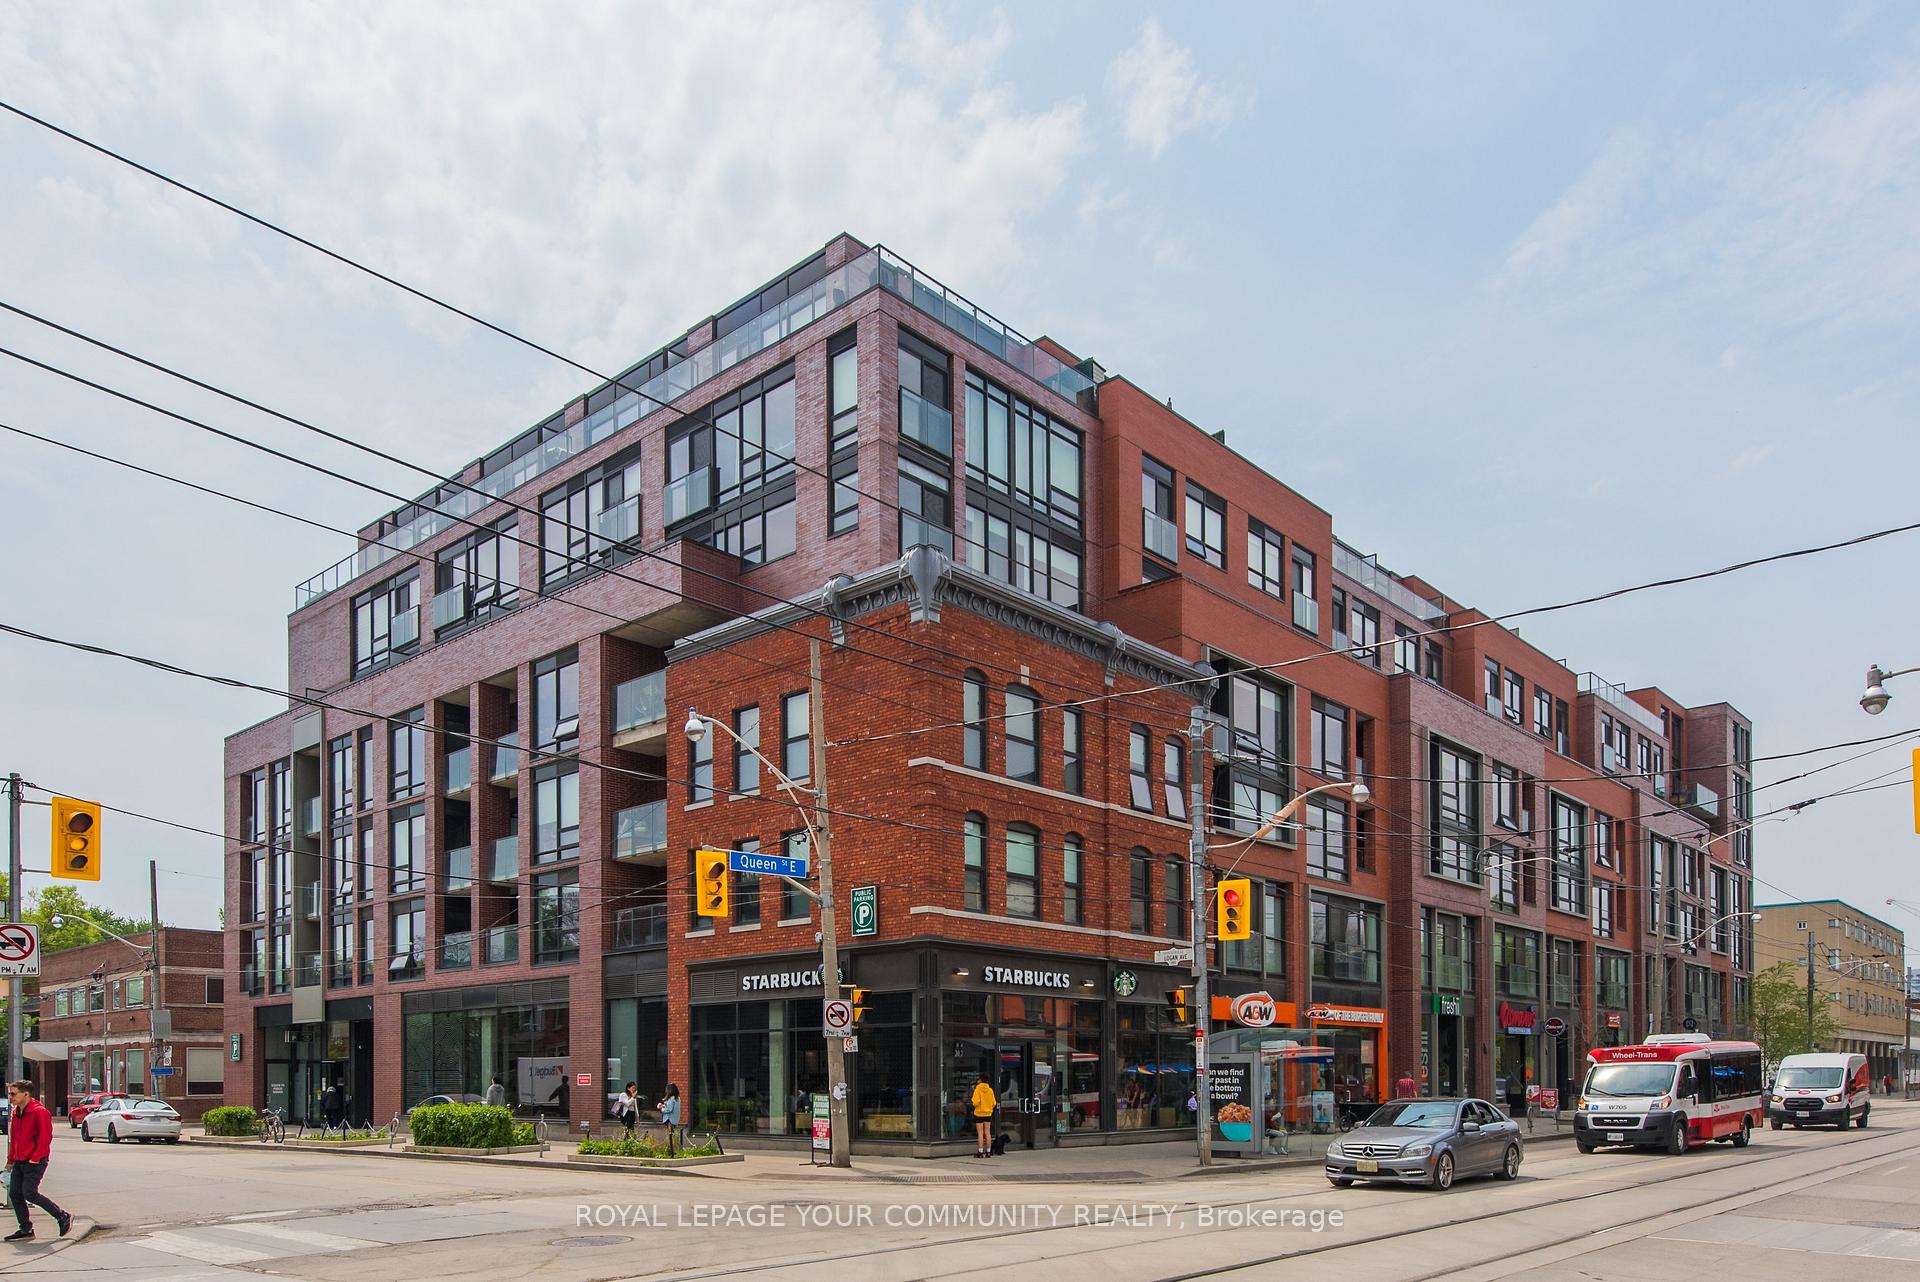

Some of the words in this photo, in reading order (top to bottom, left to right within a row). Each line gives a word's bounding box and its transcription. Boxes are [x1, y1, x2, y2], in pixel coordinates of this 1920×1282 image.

[740, 855, 777, 871] Queen
[790, 861, 796, 873] E
[854, 889, 872, 897] PUBLIC
[853, 895, 874, 903] PARKING
[859, 905, 870, 925] P
[742, 970, 821, 991] STARBUCK
[984, 965, 1070, 989] STARBUCKS
[1441, 995, 1460, 1015] freshii
[1243, 1005, 1273, 1021] A&W
[1612, 1051, 1658, 1059] Wheel-Trans
[1230, 1068, 1244, 1076] find
[1215, 1076, 1232, 1085] past
[1232, 1076, 1239, 1084] in
[1214, 1084, 1241, 1092] bottom
[1216, 1092, 1238, 1100] bowl?
